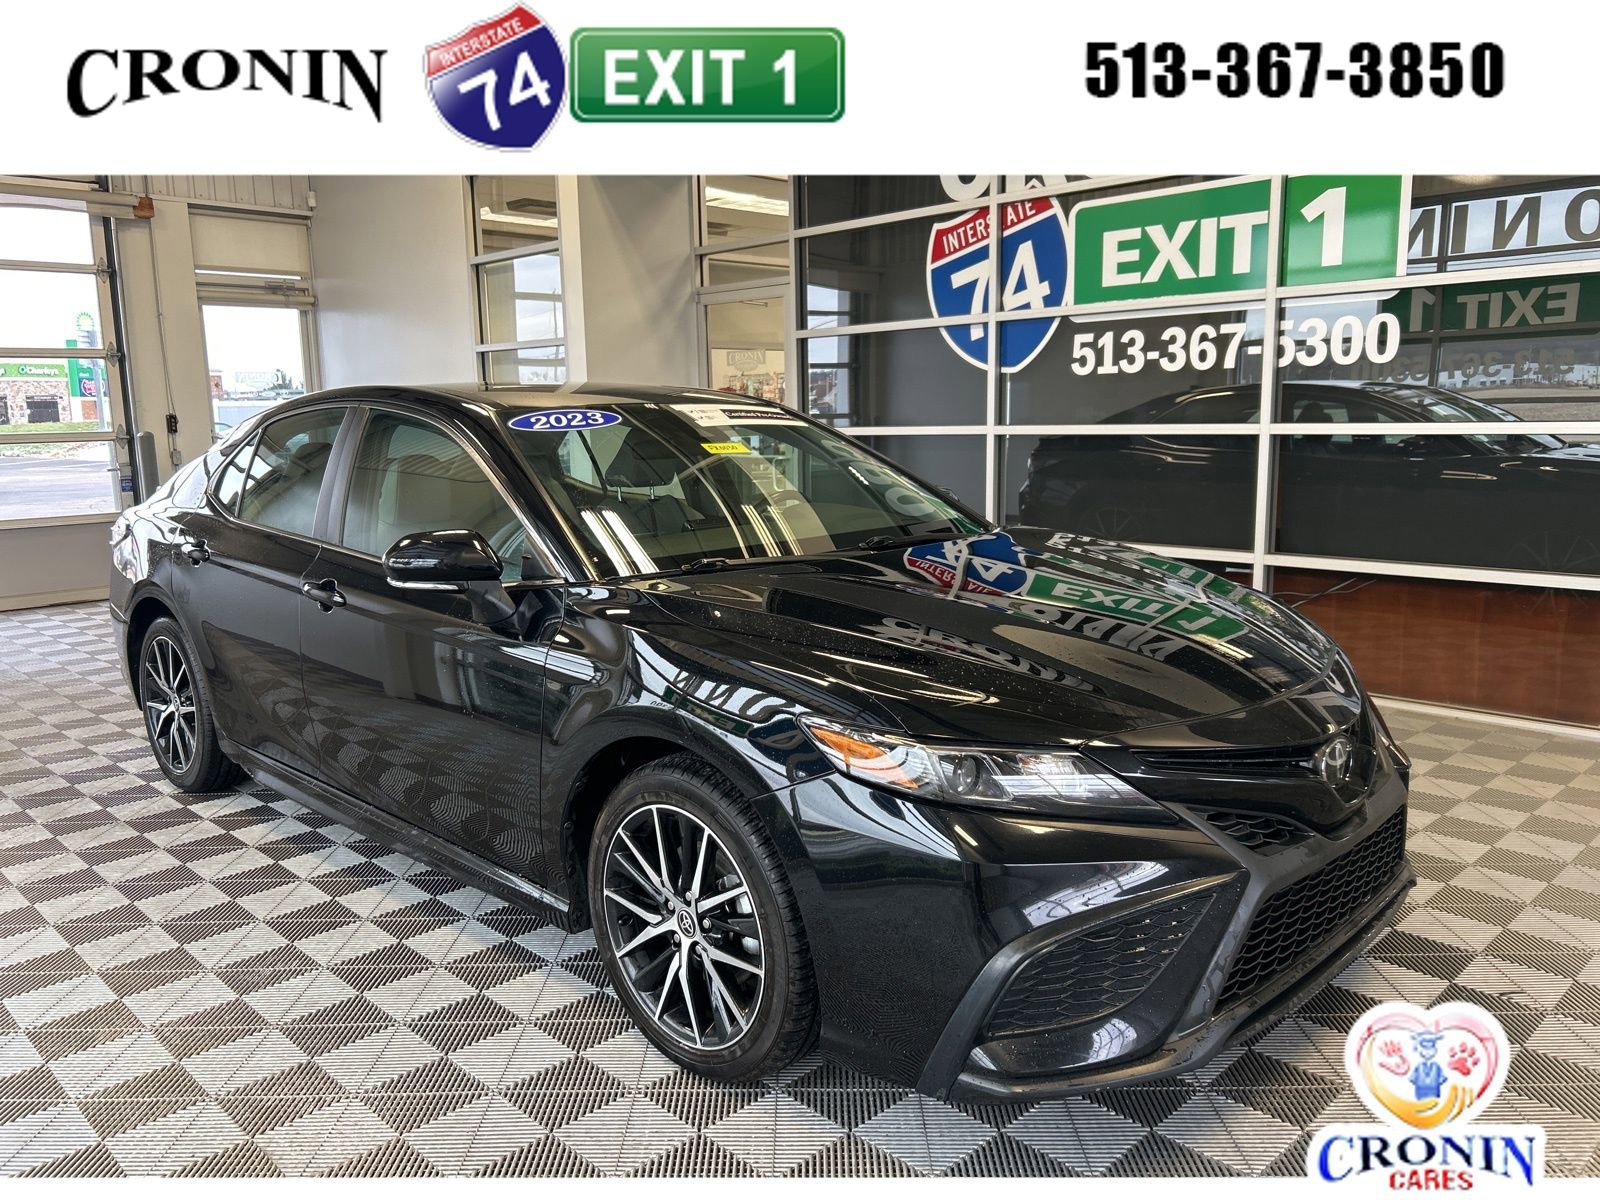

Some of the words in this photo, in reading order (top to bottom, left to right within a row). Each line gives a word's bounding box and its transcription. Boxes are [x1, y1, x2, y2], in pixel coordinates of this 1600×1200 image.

[942, 199, 1047, 255] INTERSATE
[1101, 210, 1269, 288] EXIT
[1300, 186, 1347, 267] 1
[950, 239, 1051, 342] 74
[1070, 312, 1401, 377] 513-367-5300
[529, 411, 605, 430] 2023
